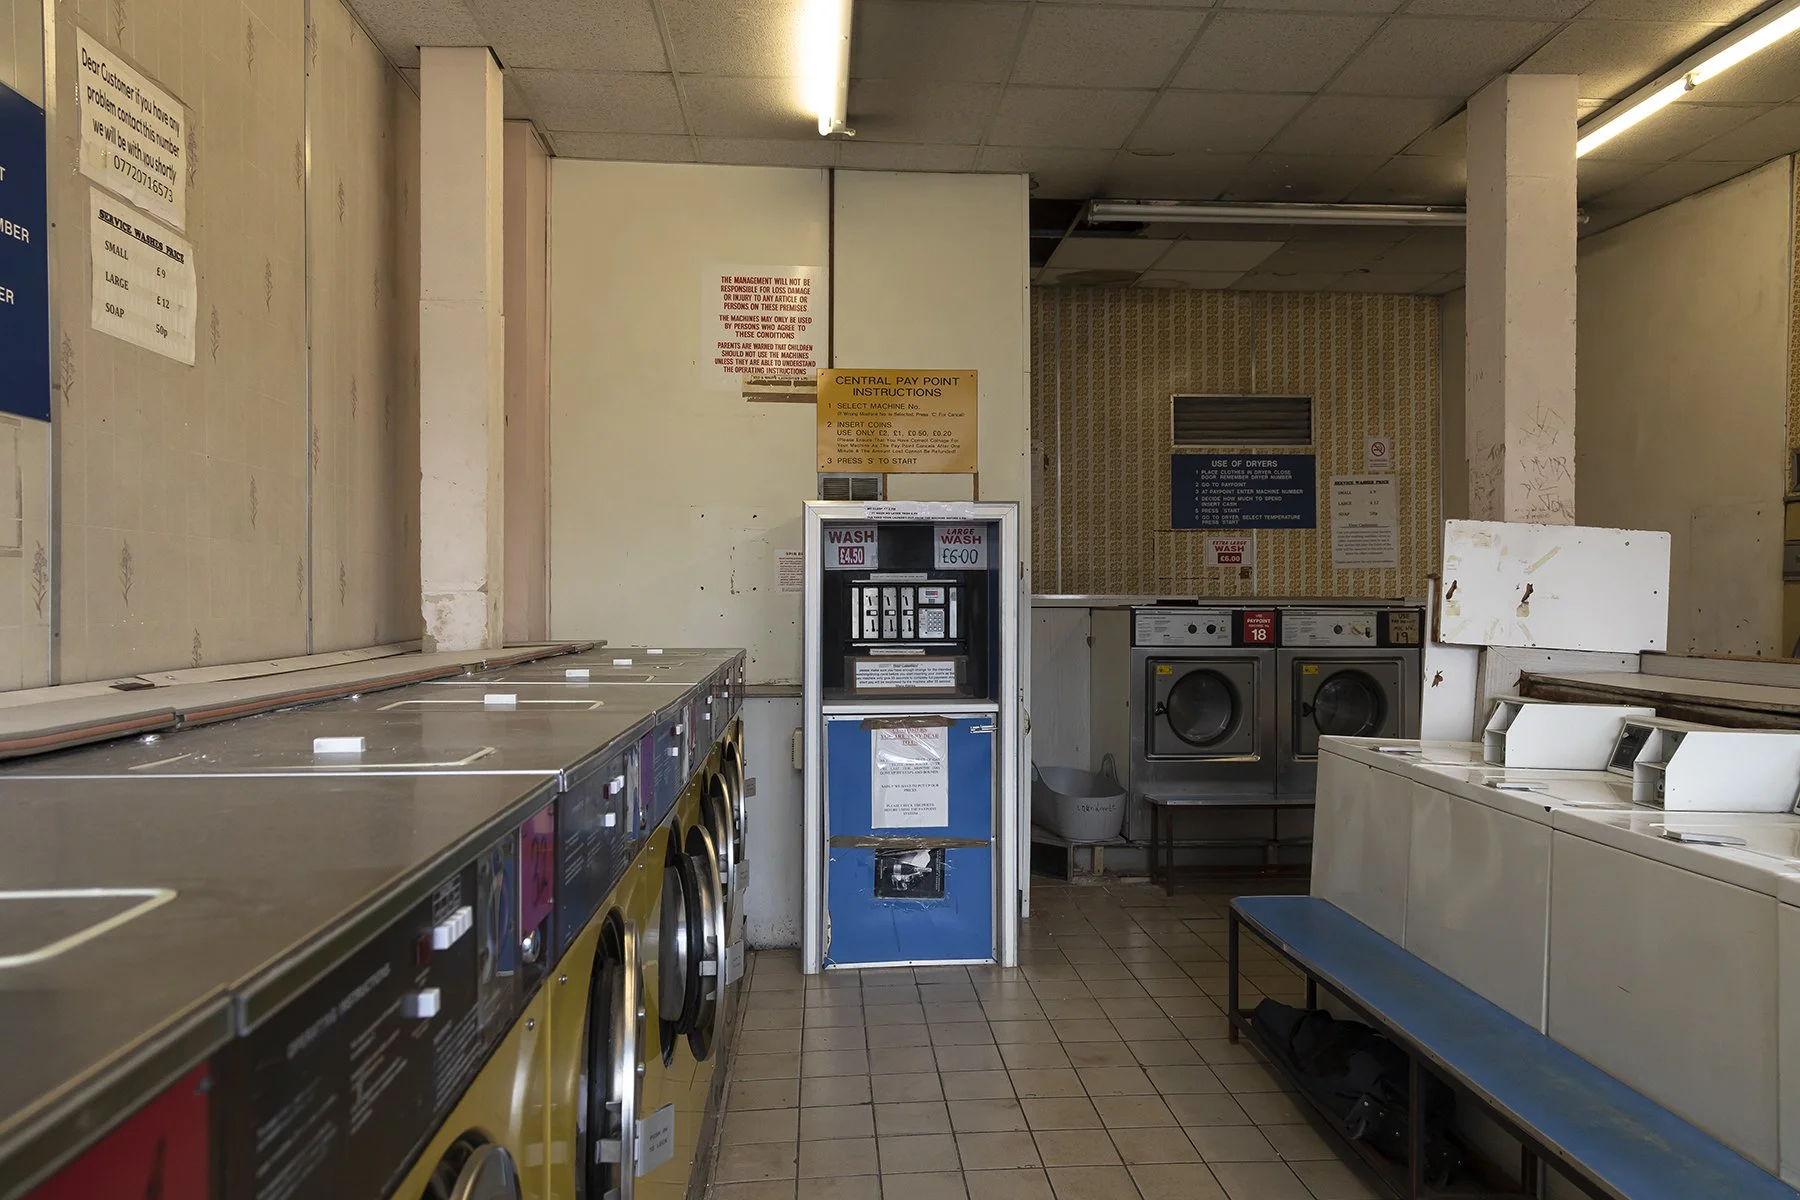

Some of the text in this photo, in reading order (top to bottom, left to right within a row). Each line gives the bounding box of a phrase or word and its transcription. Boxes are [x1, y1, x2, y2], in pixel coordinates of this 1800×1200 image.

[81, 47, 180, 138] Dear Customer if you have any
[87, 85, 180, 158] problem contact this number
[93, 118, 103, 137] we
[105, 125, 116, 145] will
[117, 130, 126, 151] be
[127, 141, 142, 163] with
[155, 157, 177, 185] shortly
[114, 155, 173, 203] 07720716573
[99, 209, 184, 262] SERVICE WASHES PRICE
[104, 240, 128, 260] SMALL
[105, 271, 129, 290] LARGE
[721, 276, 732, 284] THE
[734, 276, 772, 285] MANAGEMENT
[789, 278, 801, 286] NOT
[720, 285, 757, 293] RESPONSIBLE
[788, 287, 810, 295] DAMAGE
[733, 294, 752, 302] INJURY
[774, 295, 797, 303] ARTICLE
[105, 302, 124, 318] SOAP
[780, 304, 807, 312] PREMISES
[156, 324, 168, 338] 50p
[782, 360, 816, 368] UNDERSTAND
[766, 367, 807, 375] INSTRUCTIONS
[835, 376, 959, 386] CENTRAL PAY POINT
[853, 388, 942, 397] INSTRUCTIONS
[1246, 460, 1278, 468] DRYERS
[829, 530, 875, 543] WASH
[941, 536, 982, 545] WASH
[840, 548, 863, 564] £4.50
[1251, 629, 1267, 641] 18
[1396, 632, 1409, 643] 19
